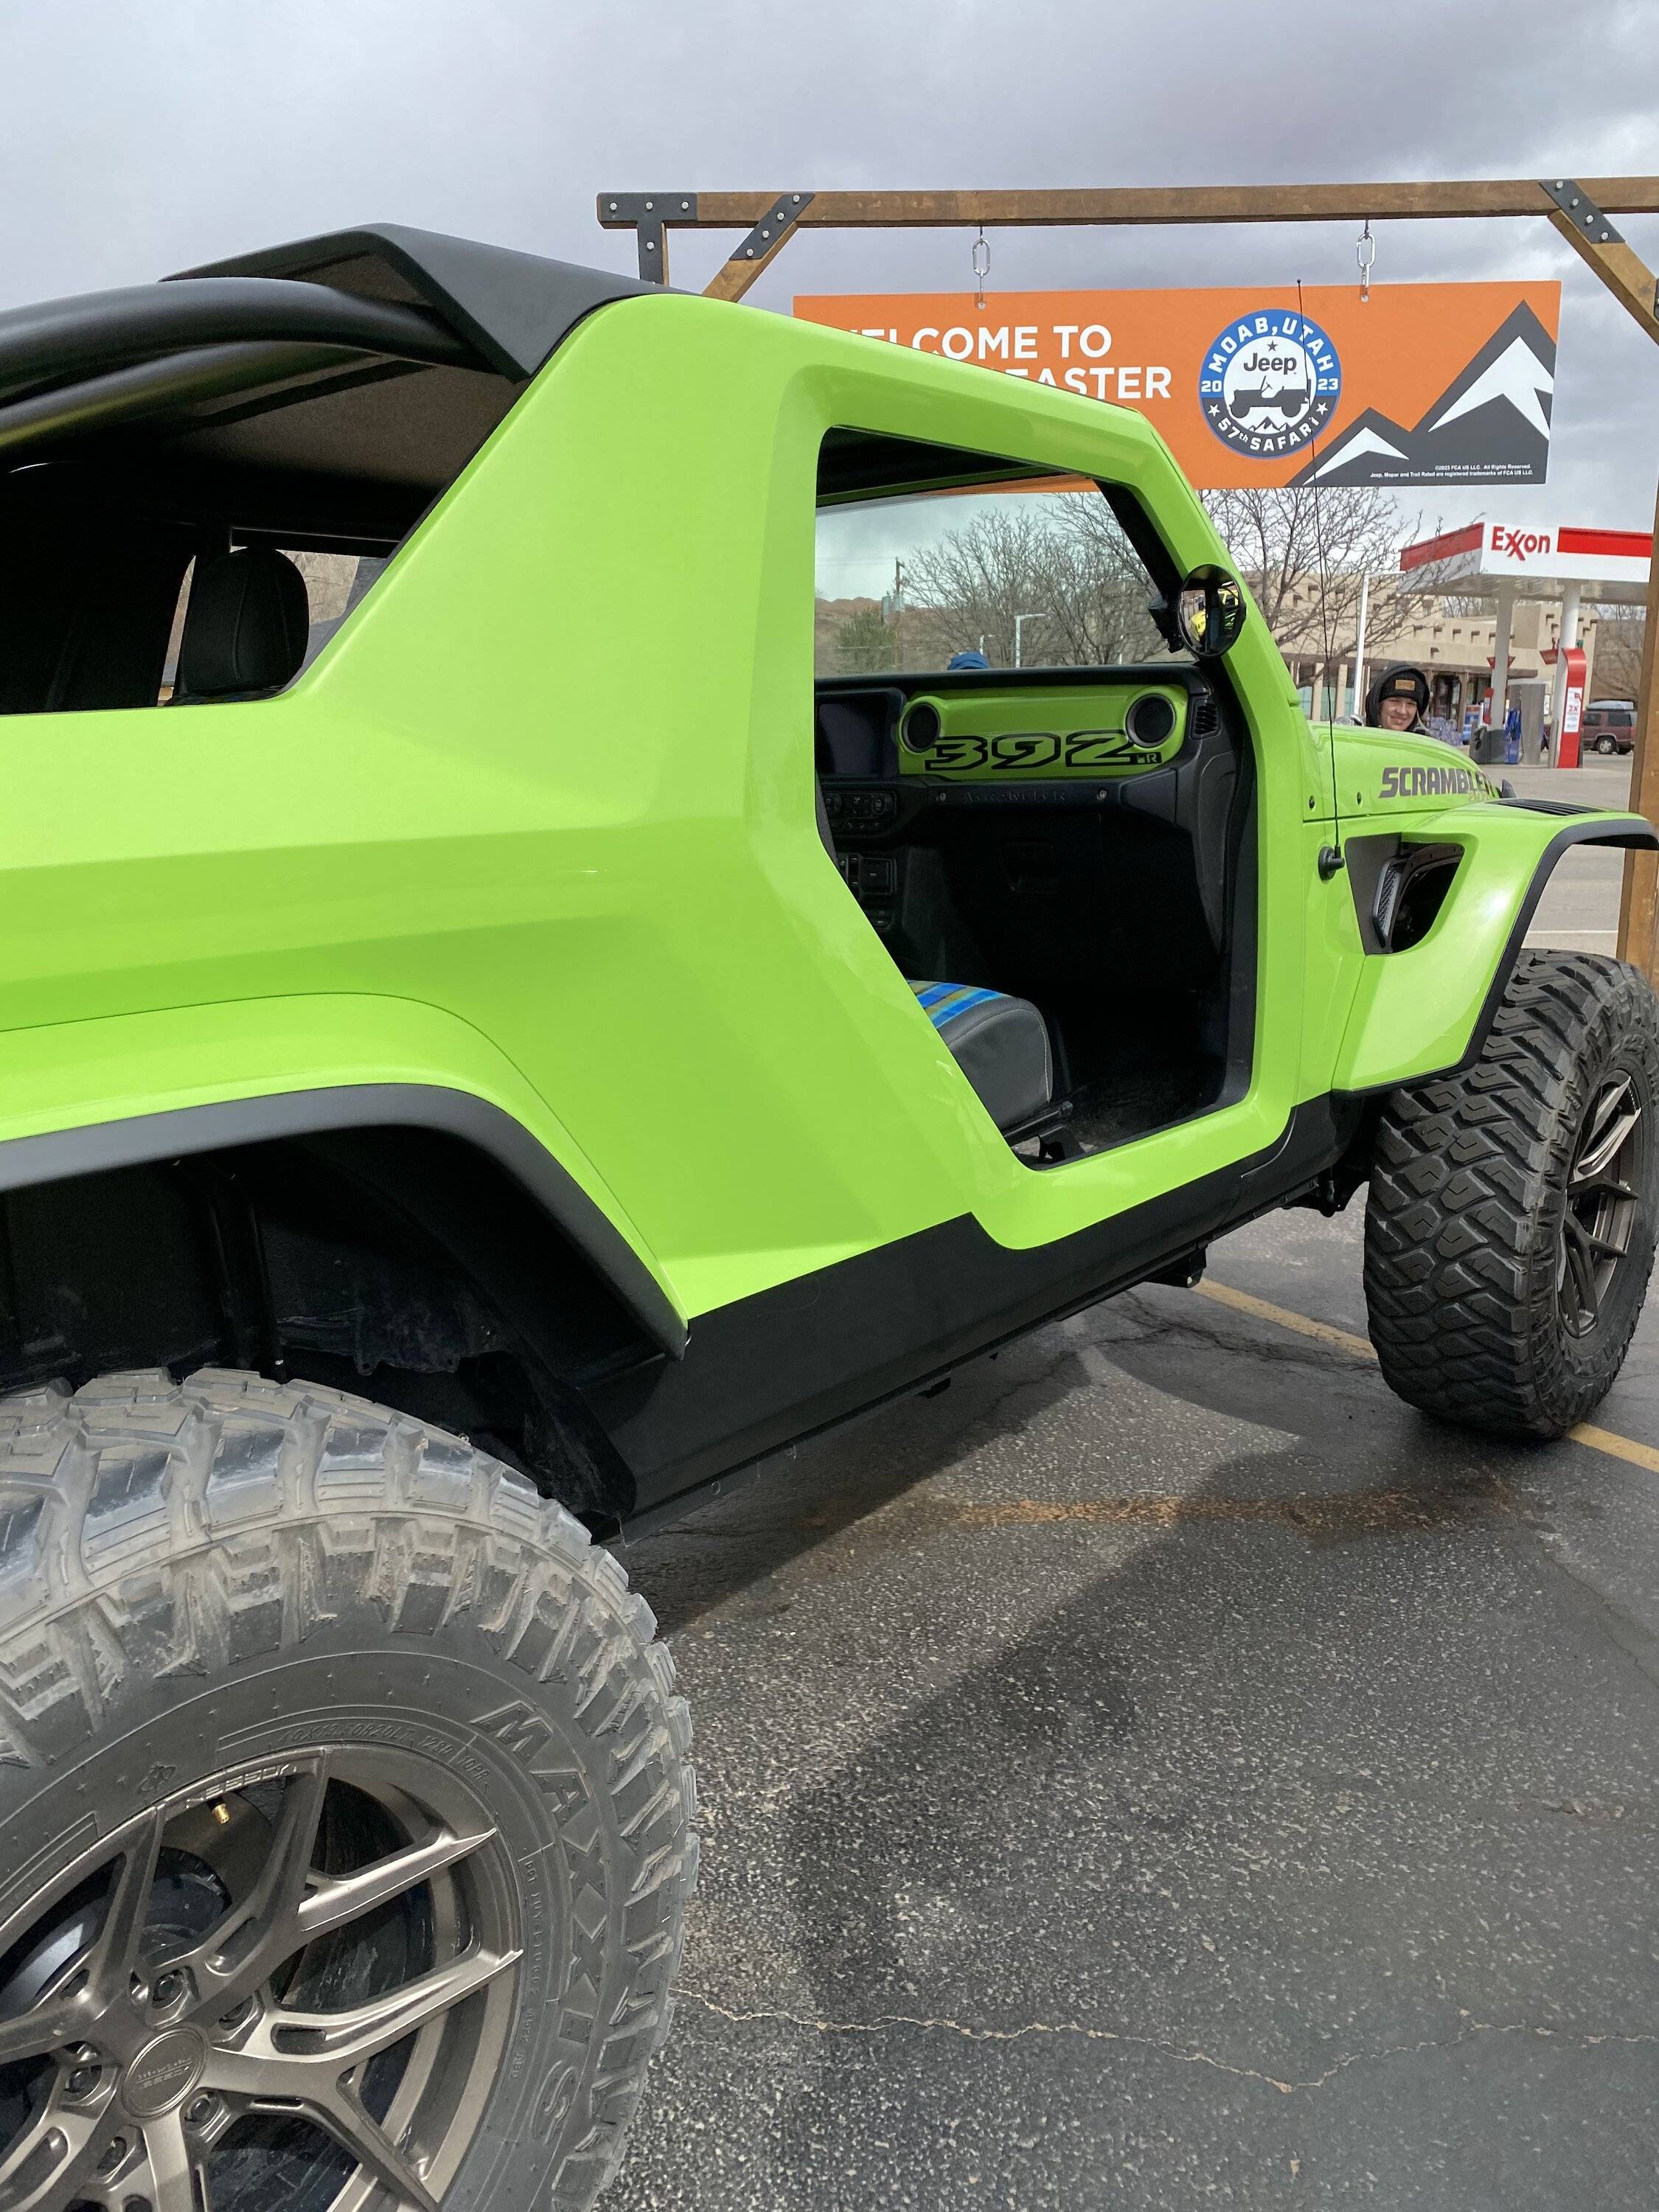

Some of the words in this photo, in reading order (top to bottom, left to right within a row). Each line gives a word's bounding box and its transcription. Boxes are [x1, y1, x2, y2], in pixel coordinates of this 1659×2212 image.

[1053, 324, 1112, 358] TO
[1282, 317, 1334, 372] UTAH
[1243, 352, 1297, 375] Jeep
[1200, 380, 1222, 392] 20
[1317, 378, 1339, 391] 23
[1218, 417, 1248, 442] 57th
[924, 729, 1134, 771] 392
[469, 1700, 608, 2146] MAXXIS
